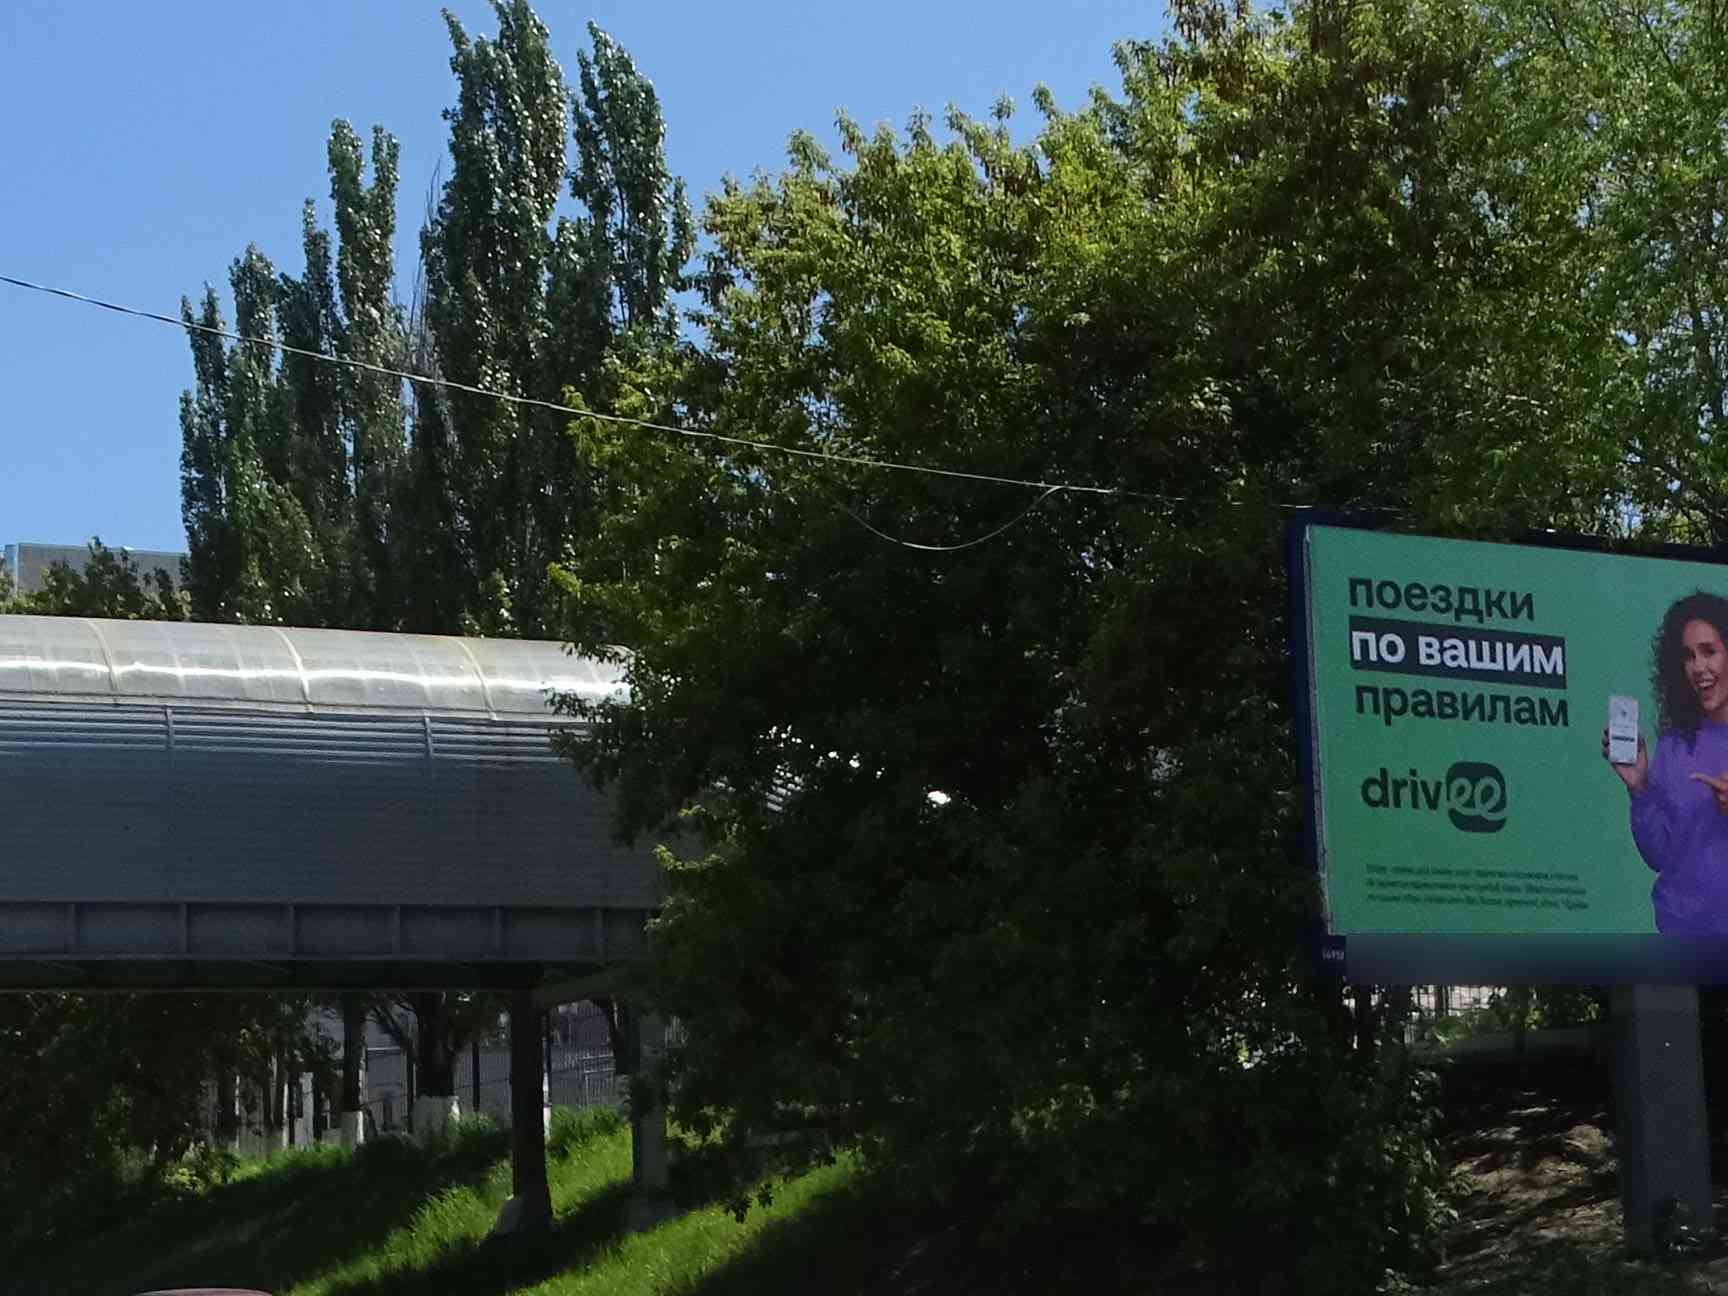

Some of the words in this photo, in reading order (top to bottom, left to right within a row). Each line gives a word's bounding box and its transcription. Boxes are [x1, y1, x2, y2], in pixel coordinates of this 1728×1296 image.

[1348, 576, 1535, 624] поездки
[1351, 630, 1406, 664] по
[1418, 635, 1565, 676] вашим
[1355, 683, 1569, 727] правилам
[1360, 762, 1507, 833] drivee
